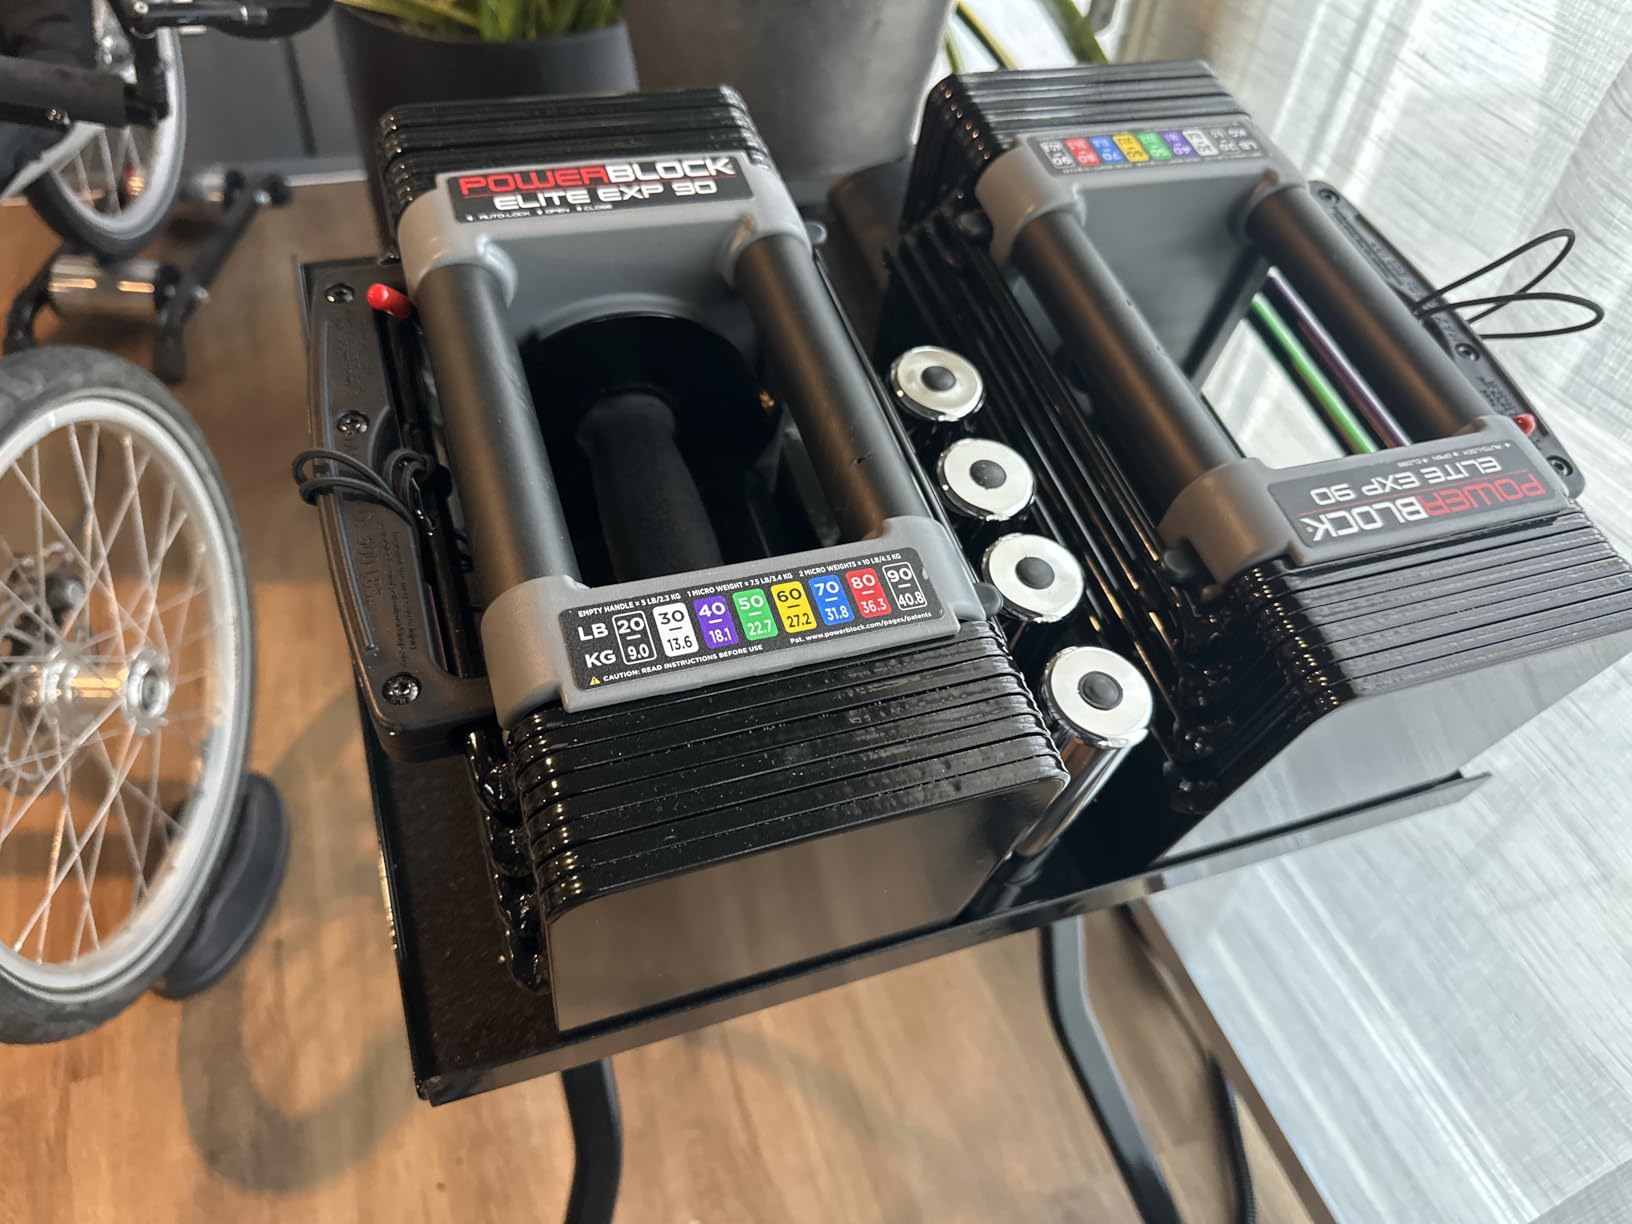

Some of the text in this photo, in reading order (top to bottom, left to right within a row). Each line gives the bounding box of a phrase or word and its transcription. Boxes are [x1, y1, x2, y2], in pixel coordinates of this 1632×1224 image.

[458, 158, 737, 195] POWERBLOCK
[1053, 156, 1073, 166] 90
[493, 179, 718, 211] ELITE EXP 90
[1310, 456, 1502, 506] ELITE EXP 90
[1300, 473, 1547, 541] POWERBLOCK
[798, 570, 804, 578] 2
[804, 566, 826, 577] MICRO
[826, 560, 857, 572] WEIGHTS
[862, 558, 871, 566] 10
[871, 554, 892, 565] LB/4.5
[891, 552, 902, 560] KG
[692, 587, 716, 597] MICRO
[715, 581, 744, 592] WEIGHT
[749, 578, 760, 586] 7.5
[760, 573, 783, 584] LB/3.4
[783, 572, 794, 580] KG
[577, 567, 912, 641] LB 20 30 40 50 60 70 80 90
[578, 606, 603, 618] EMPTY
[603, 601, 635, 613] HANDLE
[646, 594, 670, 605] LB/2.3
[670, 592, 682, 601] KG
[584, 591, 924, 669] KG 9.0 13.6 18.1 22.7 27.2 31.8 36.3 40.8
[789, 611, 932, 644] Pat. www.powerblock.com/pages/patents
[603, 644, 763, 682] CAUTION: READ INSTRUCTIONS BEFORE USE
